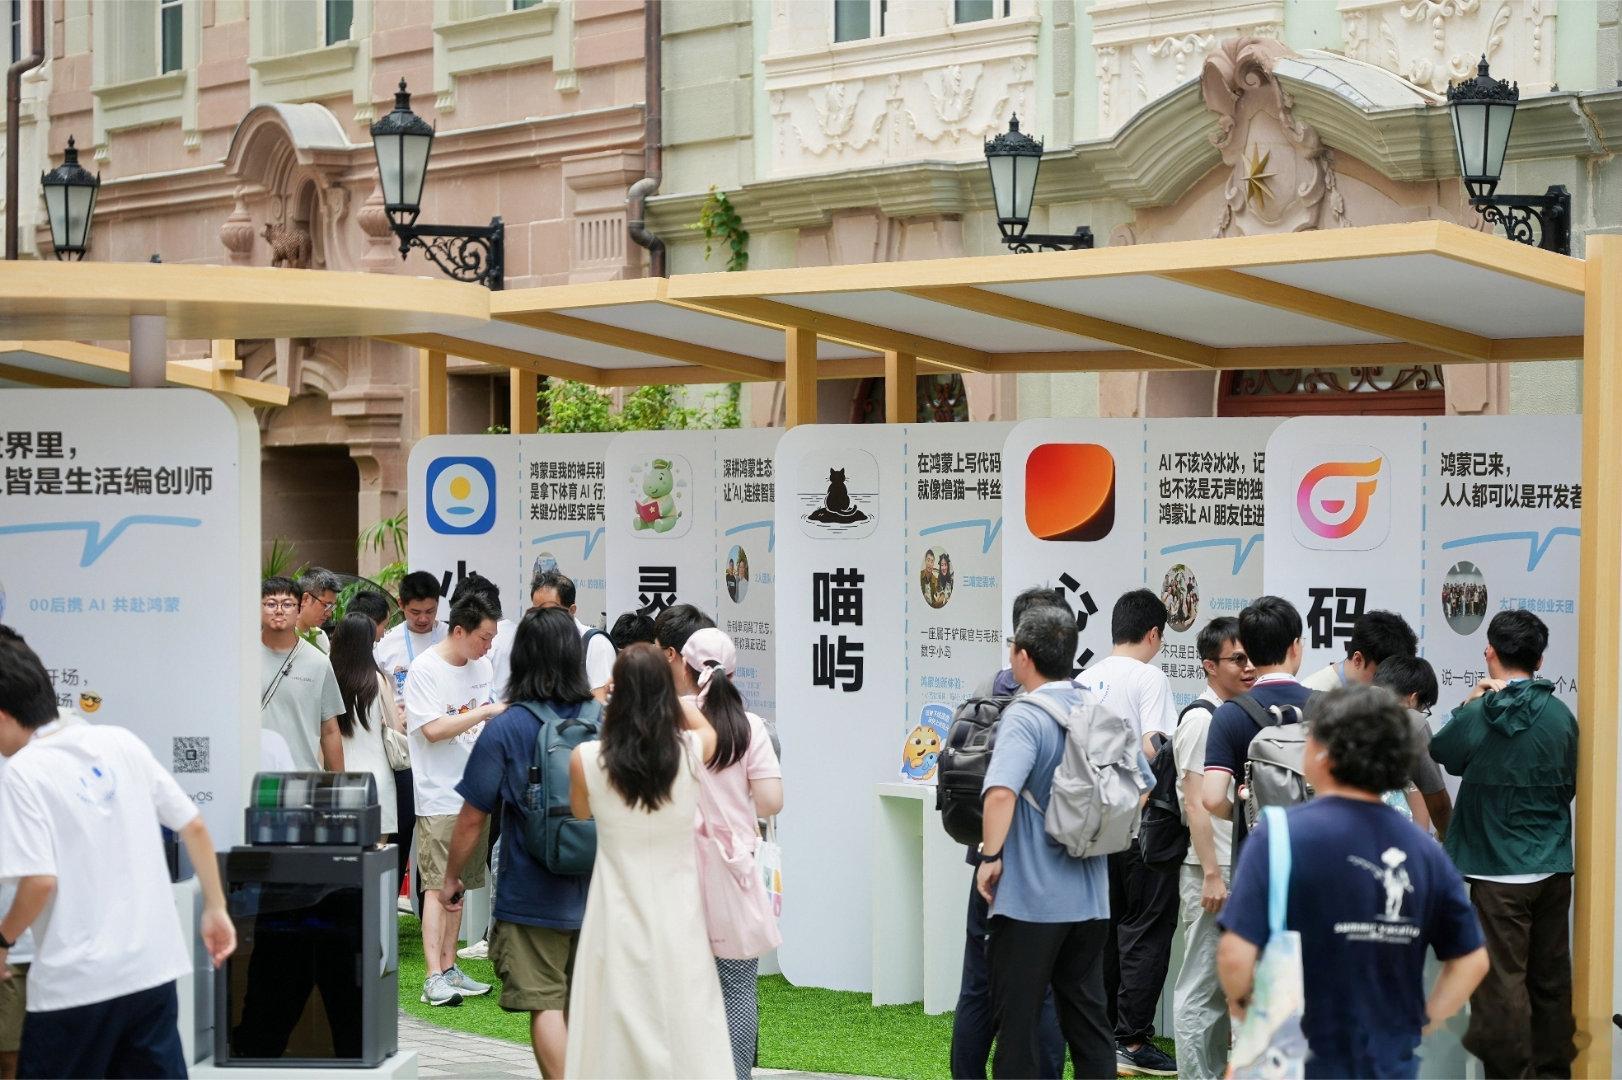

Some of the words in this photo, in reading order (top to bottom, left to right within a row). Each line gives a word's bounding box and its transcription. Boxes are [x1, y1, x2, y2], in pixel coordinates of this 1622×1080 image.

[0, 431, 76, 459] 界里，
[530, 461, 605, 479] 鸿蒙是我的神兵利
[918, 452, 1001, 473] 在鸿蒙上写代码
[1159, 454, 1171, 471] AI
[1441, 452, 1510, 477] 鸿蒙已来，
[0, 466, 212, 495] 皆是生活编创师
[530, 482, 577, 500] 是拿下体育
[580, 484, 590, 498] AI
[918, 479, 1001, 500] 就像撸猫一样丝
[1160, 477, 1263, 500] 也不该是无声的独
[1440, 482, 1582, 509] 人人都可以是开发者
[530, 503, 605, 521] 关键分的坚实底气
[1159, 503, 1196, 524] 鸿蒙让
[1199, 506, 1211, 522] AI
[1213, 504, 1264, 526] 朋友住进
[88, 598, 105, 612] AI
[1306, 588, 1366, 652] 码
